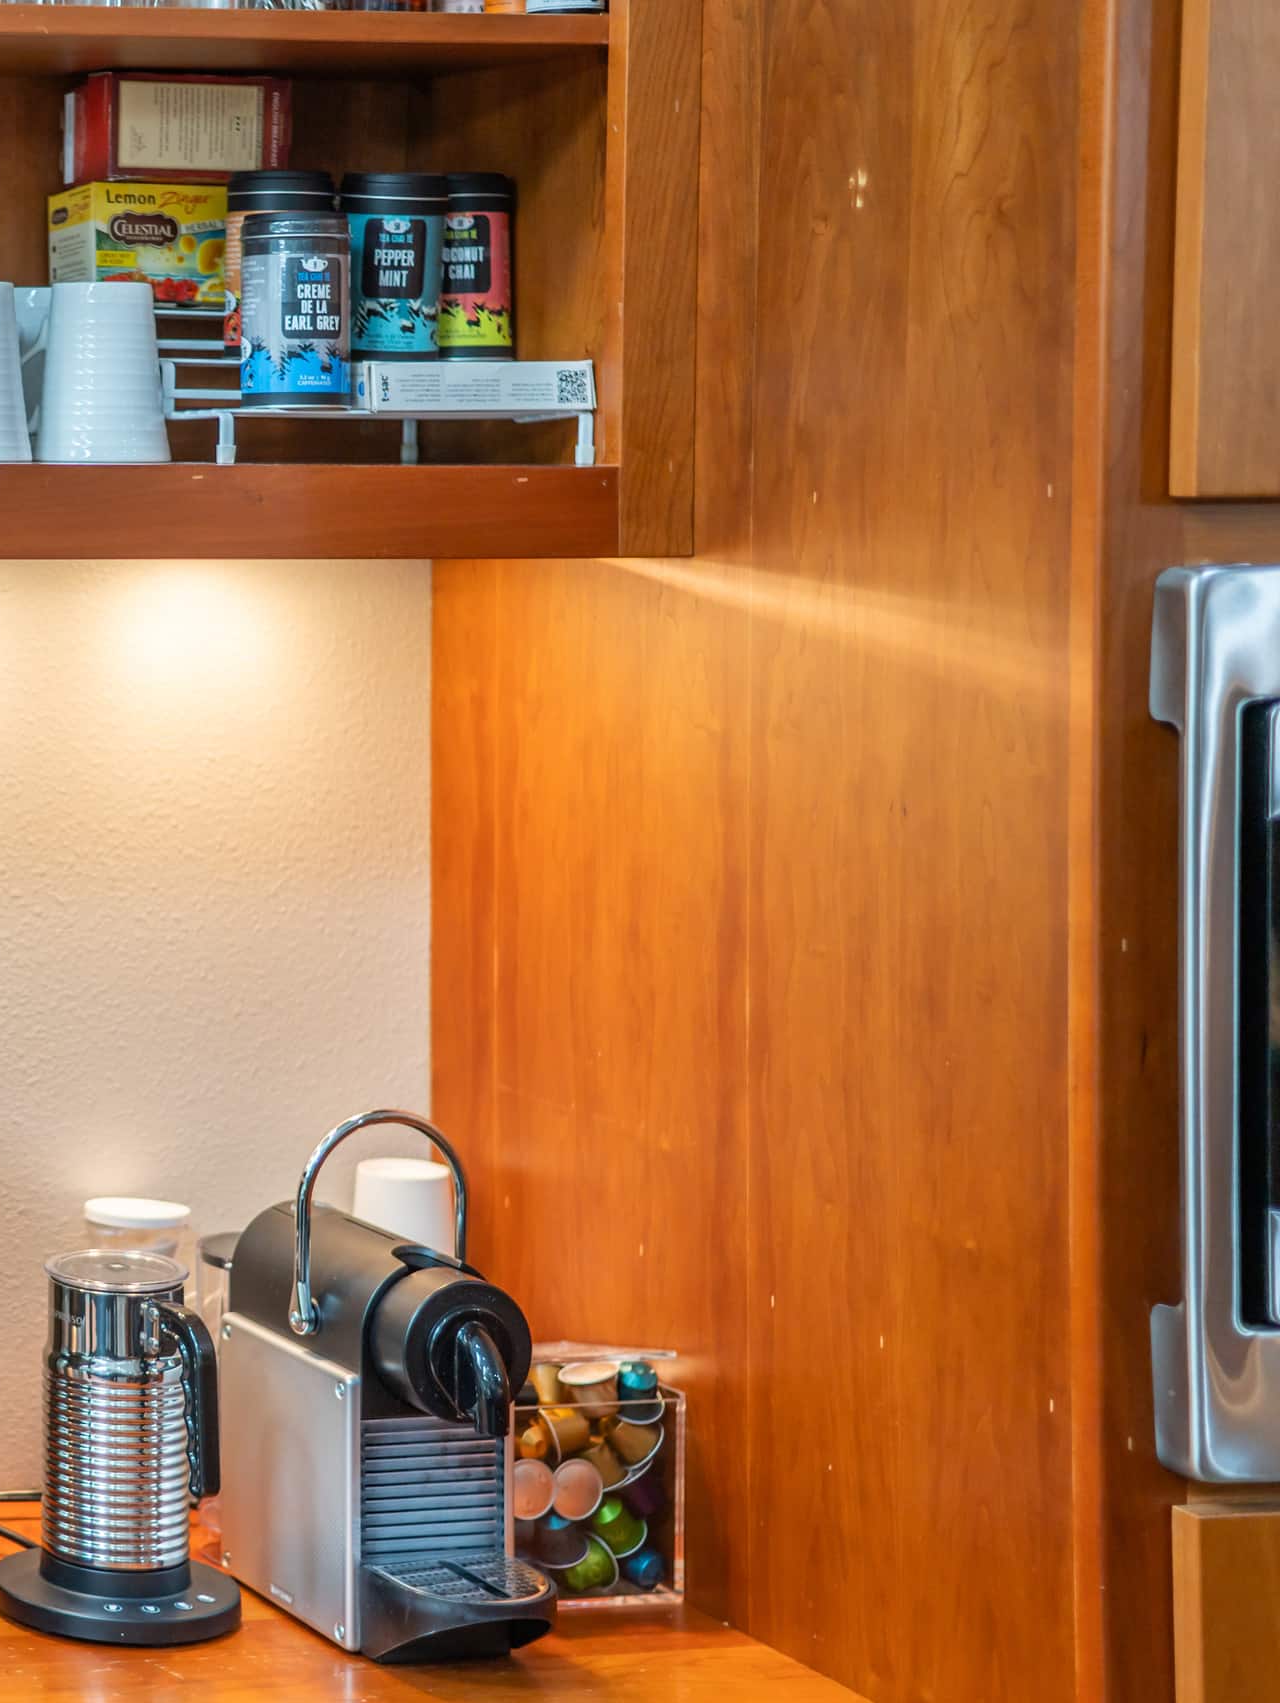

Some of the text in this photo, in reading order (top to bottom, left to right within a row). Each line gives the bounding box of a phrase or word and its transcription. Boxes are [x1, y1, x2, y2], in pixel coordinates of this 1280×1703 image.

[106, 189, 157, 205] Lemon
[112, 219, 175, 238] CELESTIAL
[374, 249, 415, 267] PEPPER
[441, 246, 485, 263] OCONUT
[378, 270, 409, 287] MINT
[448, 264, 475, 279] CHAI
[297, 284, 331, 299] CREME
[301, 300, 328, 314] DE LA
[284, 315, 340, 331] EARL GREY
